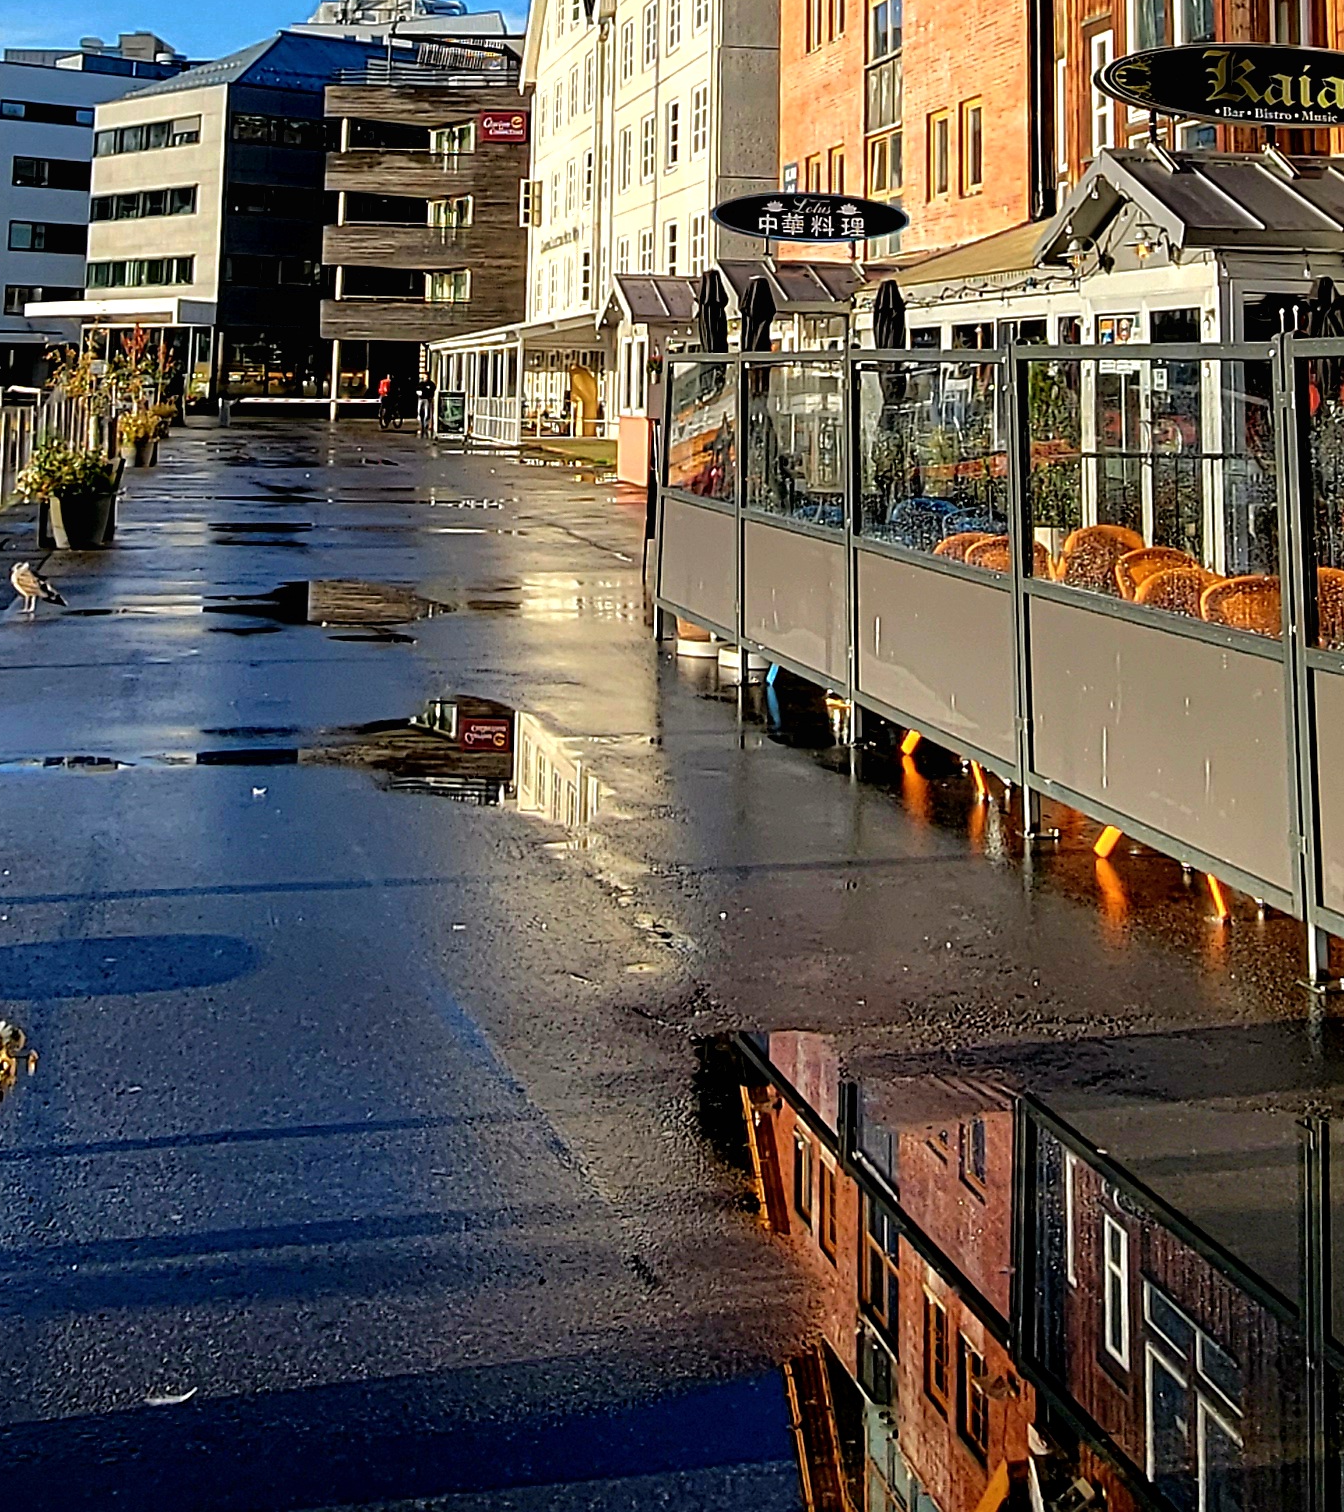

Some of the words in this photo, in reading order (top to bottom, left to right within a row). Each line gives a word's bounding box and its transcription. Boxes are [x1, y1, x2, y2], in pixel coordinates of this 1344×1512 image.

[1222, 106, 1245, 118] Bar
[1254, 107, 1292, 121] Bistro
[1301, 110, 1338, 123] Music
[792, 196, 832, 214] Lotus
[758, 213, 866, 238] 中華料理
